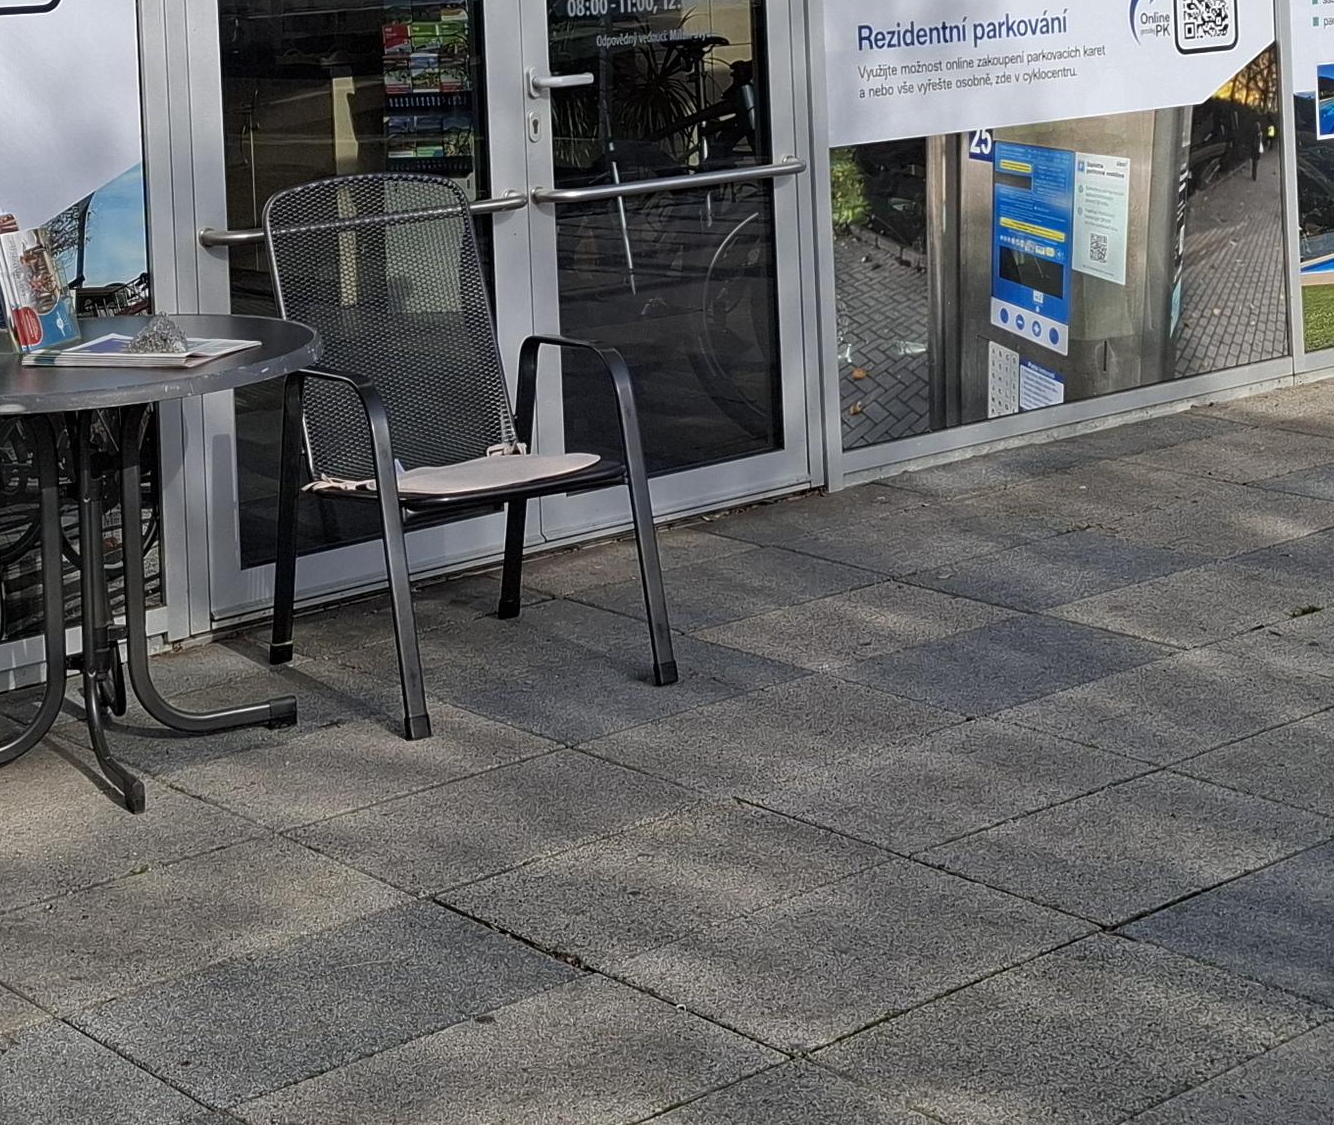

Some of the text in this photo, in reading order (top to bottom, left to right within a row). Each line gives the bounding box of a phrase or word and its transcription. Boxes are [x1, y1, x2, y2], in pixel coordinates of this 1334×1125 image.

[858, 8, 1068, 52] Rezidentní parkování
[970, 129, 992, 154] 25
